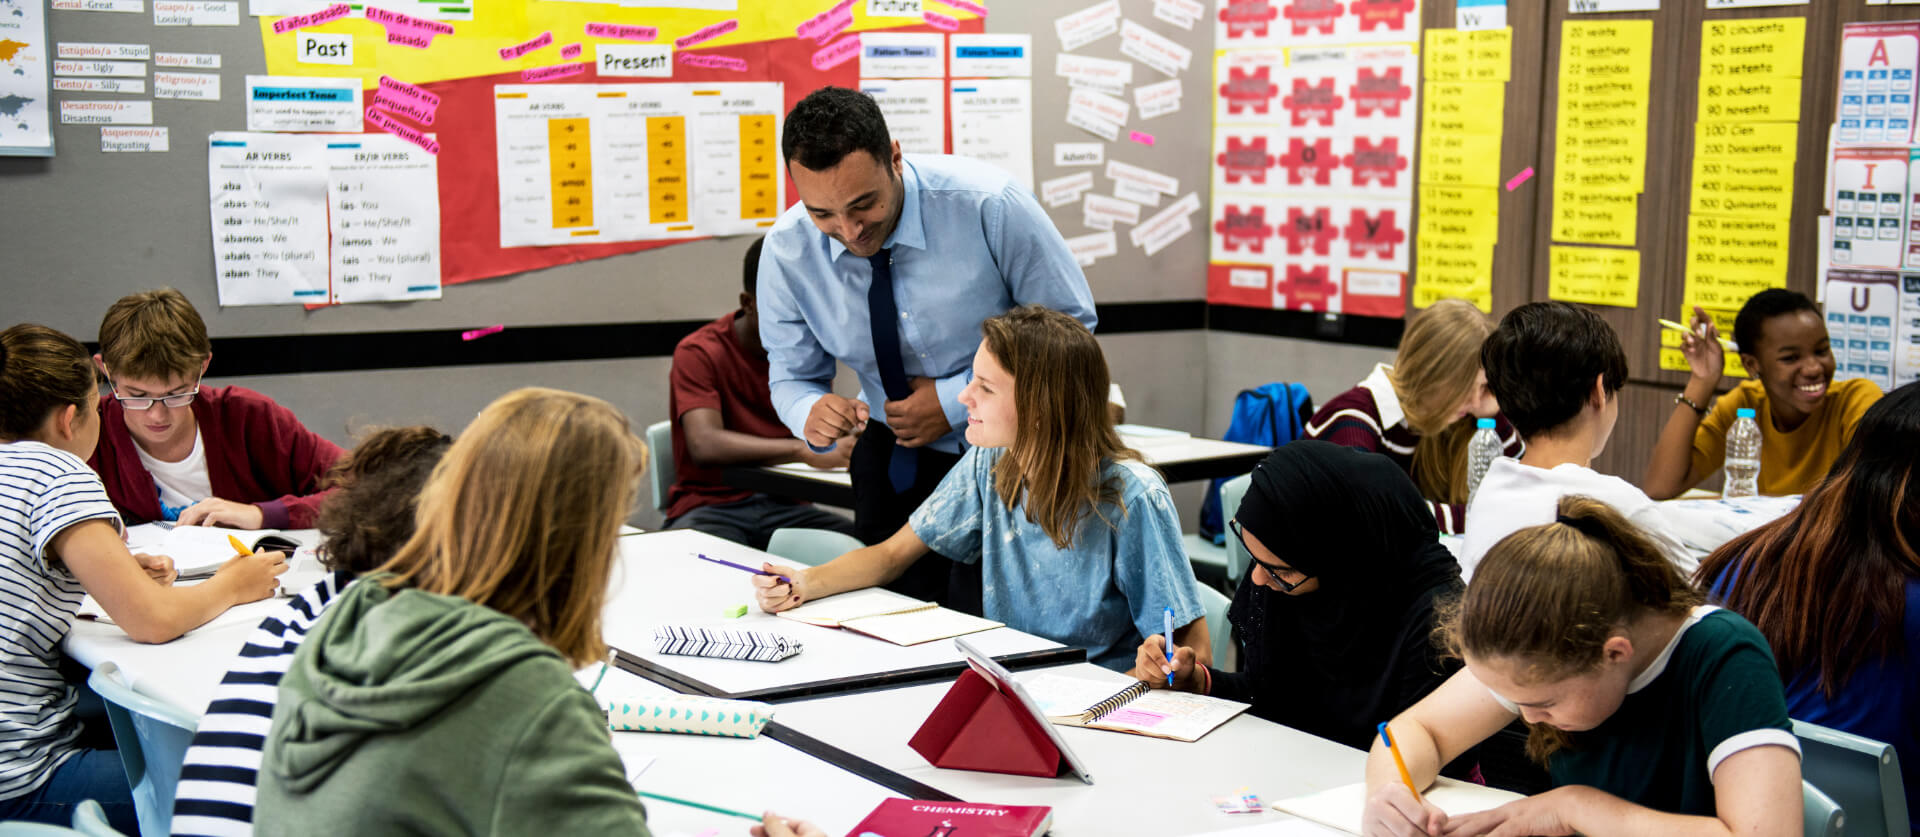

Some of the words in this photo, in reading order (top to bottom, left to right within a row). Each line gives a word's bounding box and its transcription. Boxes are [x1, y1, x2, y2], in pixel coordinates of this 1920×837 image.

[203, 3, 227, 12] Good
[873, 0, 918, 11] Future
[156, 15, 192, 25] Looking
[273, 22, 284, 33] El
[287, 16, 308, 29] año
[311, 4, 350, 23] pasado
[366, 7, 376, 18] El
[379, 9, 393, 22] fin
[396, 13, 409, 24] de
[412, 19, 453, 34] semana
[619, 27, 656, 38] general
[1712, 24, 1726, 37] 50
[1730, 23, 1785, 36] cincuenta
[388, 32, 427, 48] pasado
[514, 34, 552, 56] general
[59, 46, 111, 56] Estúpido/a
[119, 46, 149, 57] Stupid
[306, 39, 347, 57] Past
[1711, 44, 1725, 56] 60
[1730, 43, 1773, 54] sesenta
[1868, 39, 1889, 66] A
[155, 55, 188, 65] Malo/a
[195, 56, 213, 65] Bad
[604, 53, 666, 70] Present
[55, 62, 83, 73] Feo/a
[93, 63, 114, 73] Ugly
[1711, 63, 1724, 75] 70
[1729, 63, 1773, 74] setenta
[55, 79, 93, 90] Tonto/a
[100, 80, 120, 91] Silly
[154, 74, 207, 85] Peligroso/a
[155, 87, 203, 97] Dangerous
[254, 89, 306, 101] Imperfect
[308, 91, 337, 99] Tense
[380, 76, 419, 98] Cuando
[422, 93, 437, 104] era
[1707, 85, 1722, 98] 80
[1726, 84, 1772, 97] ochenta
[62, 101, 124, 112] Desastroso/a
[374, 96, 432, 122] pequeño/a
[1707, 104, 1722, 116] 90
[1726, 104, 1770, 115] noventa
[63, 114, 112, 122] Disastrous
[102, 127, 160, 138] Asqueroso/a
[368, 109, 382, 121] De
[383, 120, 439, 152] pequeño/a
[1705, 125, 1727, 137] 100
[1731, 126, 1755, 136] Cien
[102, 141, 150, 151] Disgusting
[1704, 144, 1723, 154] 200
[245, 152, 259, 161] AR
[261, 152, 292, 161] VERBS
[382, 152, 409, 161] VERBS
[1862, 163, 1878, 190] I
[1702, 181, 1721, 192] 400
[1700, 198, 1720, 209] 500
[254, 215, 299, 226] He/She/It
[363, 216, 411, 228] He/She/It
[1697, 219, 1717, 229] 600
[271, 234, 287, 243] We
[1697, 234, 1717, 246] 700
[263, 251, 279, 260] You
[281, 250, 315, 261] (plural)
[377, 254, 395, 264] You
[397, 252, 431, 264] (plural)
[1696, 254, 1716, 264] 800
[257, 267, 280, 279] They
[369, 271, 392, 283] They
[1851, 287, 1870, 312] U
[911, 804, 1009, 817] CHEMISTRY
